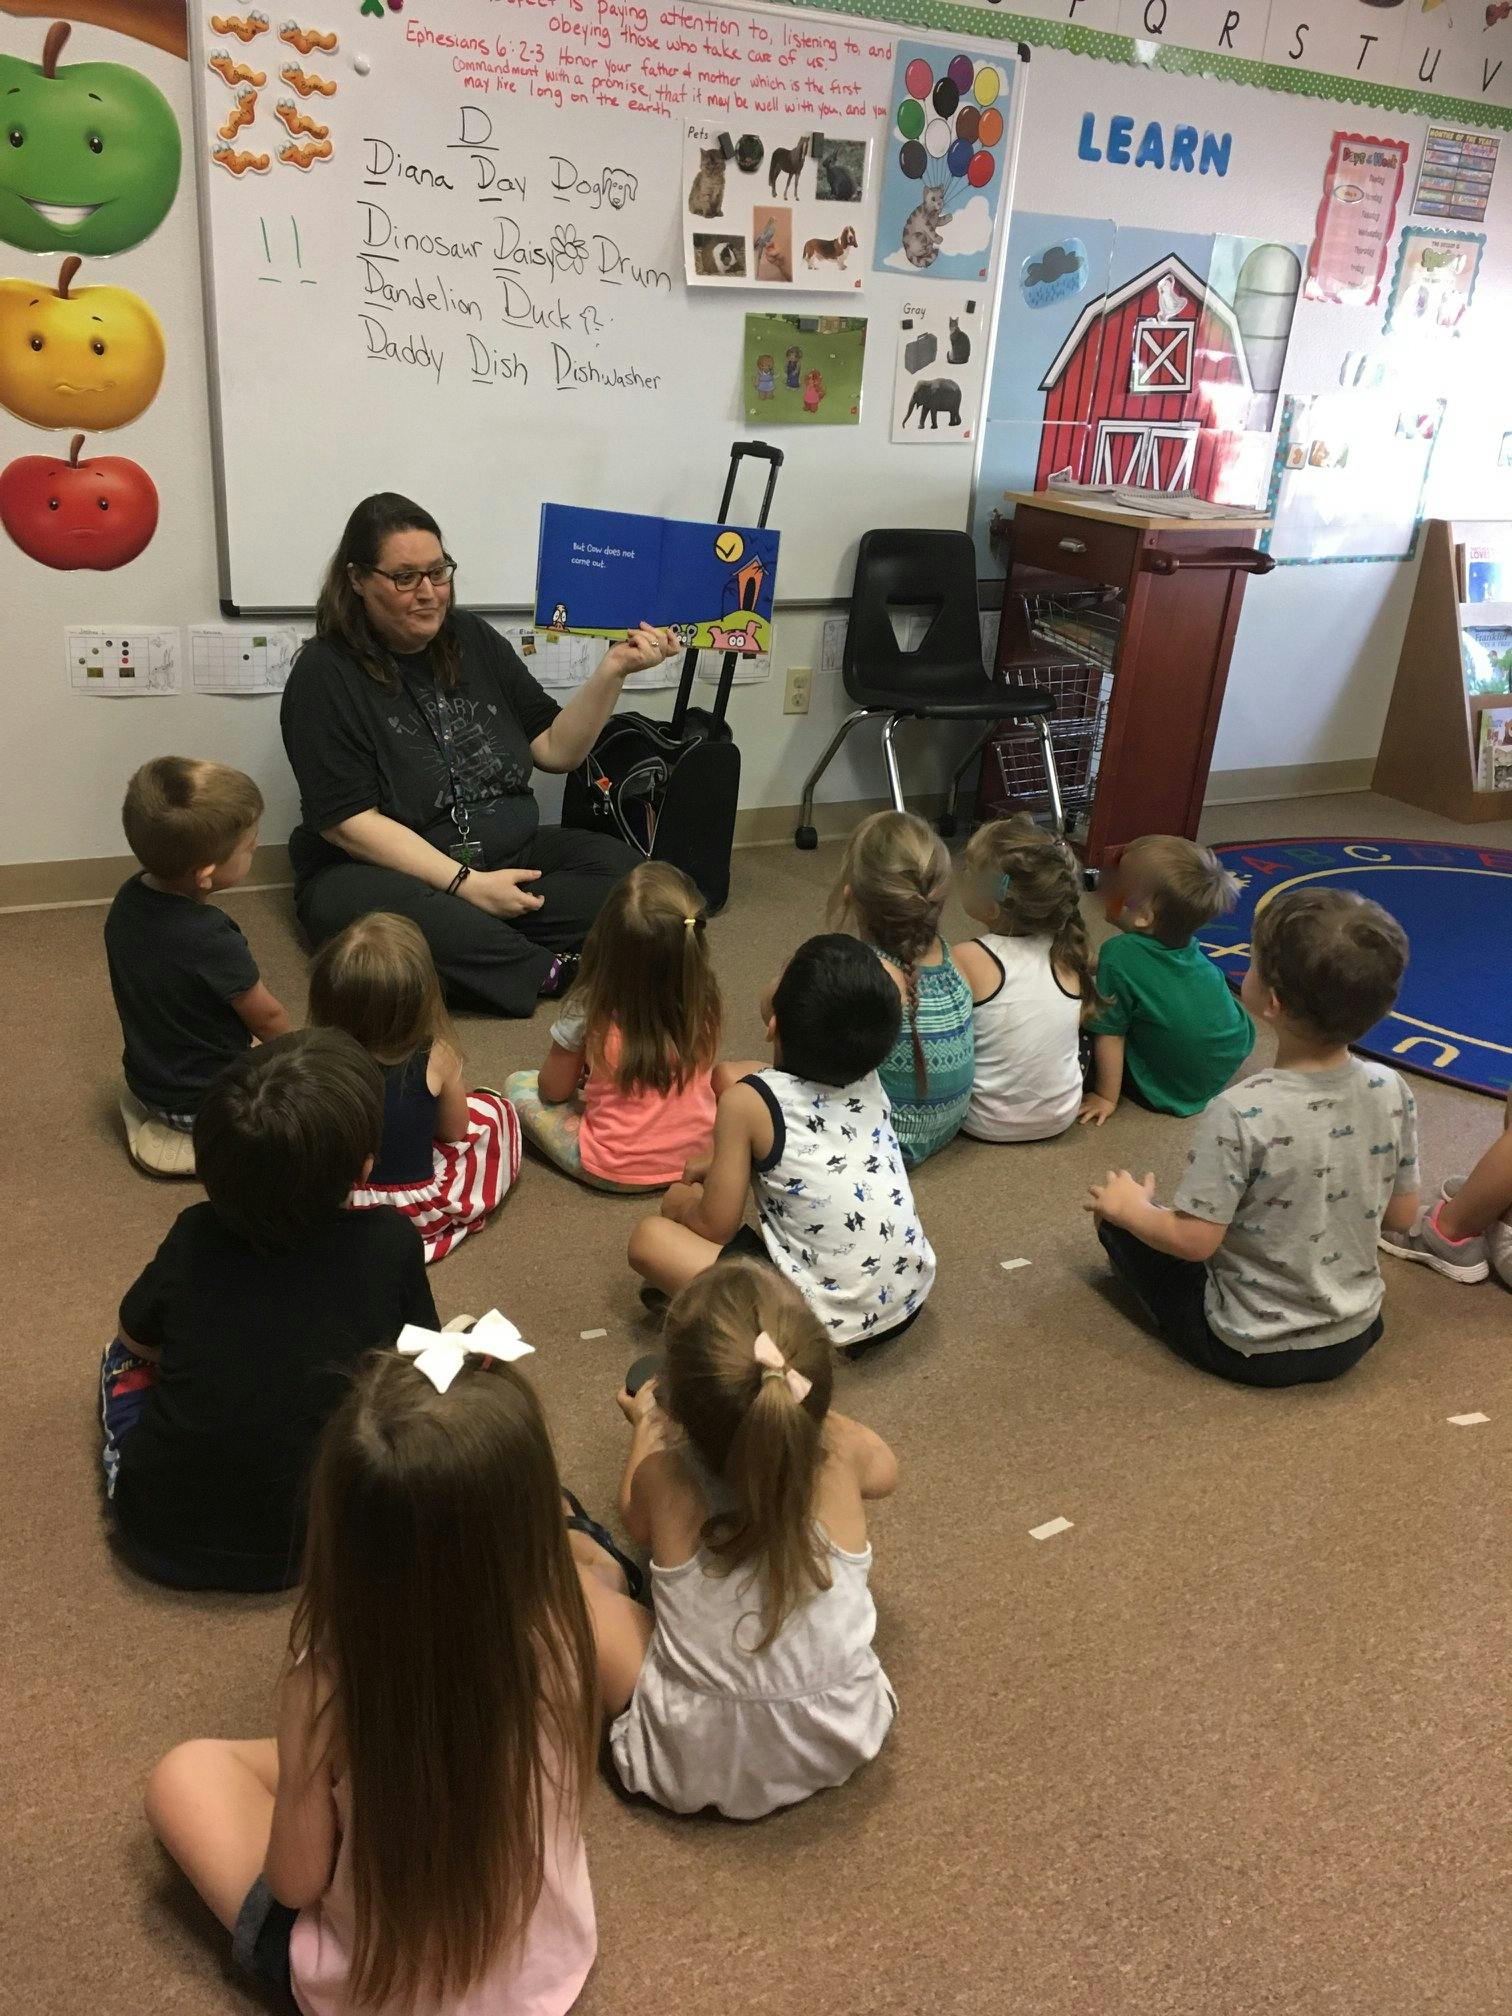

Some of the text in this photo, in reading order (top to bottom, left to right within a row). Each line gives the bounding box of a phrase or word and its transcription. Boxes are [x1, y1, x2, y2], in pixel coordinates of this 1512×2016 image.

[620, 25, 660, 50] those
[666, 35, 698, 54] who
[703, 37, 742, 61] take
[778, 49, 797, 67] of
[660, 6, 740, 37] attention
[748, 18, 773, 46] to,
[783, 23, 838, 62] listening
[868, 42, 893, 60] and
[1143, 0, 1503, 92] Q R S T U V
[405, 19, 490, 56] Ephesians
[558, 46, 598, 69] Honor
[640, 56, 679, 78] father
[698, 69, 741, 87] mother
[749, 74, 787, 92] which
[790, 77, 800, 92] is
[804, 75, 825, 95] the
[829, 78, 862, 96] first
[463, 75, 490, 94] may
[496, 75, 517, 93] live
[530, 79, 564, 108] long
[570, 91, 589, 104] on
[596, 91, 619, 107] the
[573, 74, 584, 85] a
[655, 83, 688, 104] that
[692, 87, 702, 104] it
[707, 92, 730, 113] may
[733, 91, 748, 109] be
[754, 96, 779, 113] well
[785, 97, 814, 113] with
[845, 100, 867, 116] and
[459, 105, 493, 145] D
[687, 126, 709, 141] Pets
[1077, 111, 1233, 177] LEARN
[363, 137, 602, 209] Diana Day Dog
[356, 200, 484, 259] Dinosaur
[493, 216, 556, 284] Daisy
[592, 235, 673, 292] Drum
[356, 255, 572, 330] Dandelion Duck
[903, 302, 927, 319] Gray
[358, 313, 663, 390] Daddy Dish Dishwasher
[571, 557, 591, 567] come
[572, 542, 636, 559] But Cow does not
[1240, 855, 1294, 876] A
[1343, 845, 1392, 862] C
